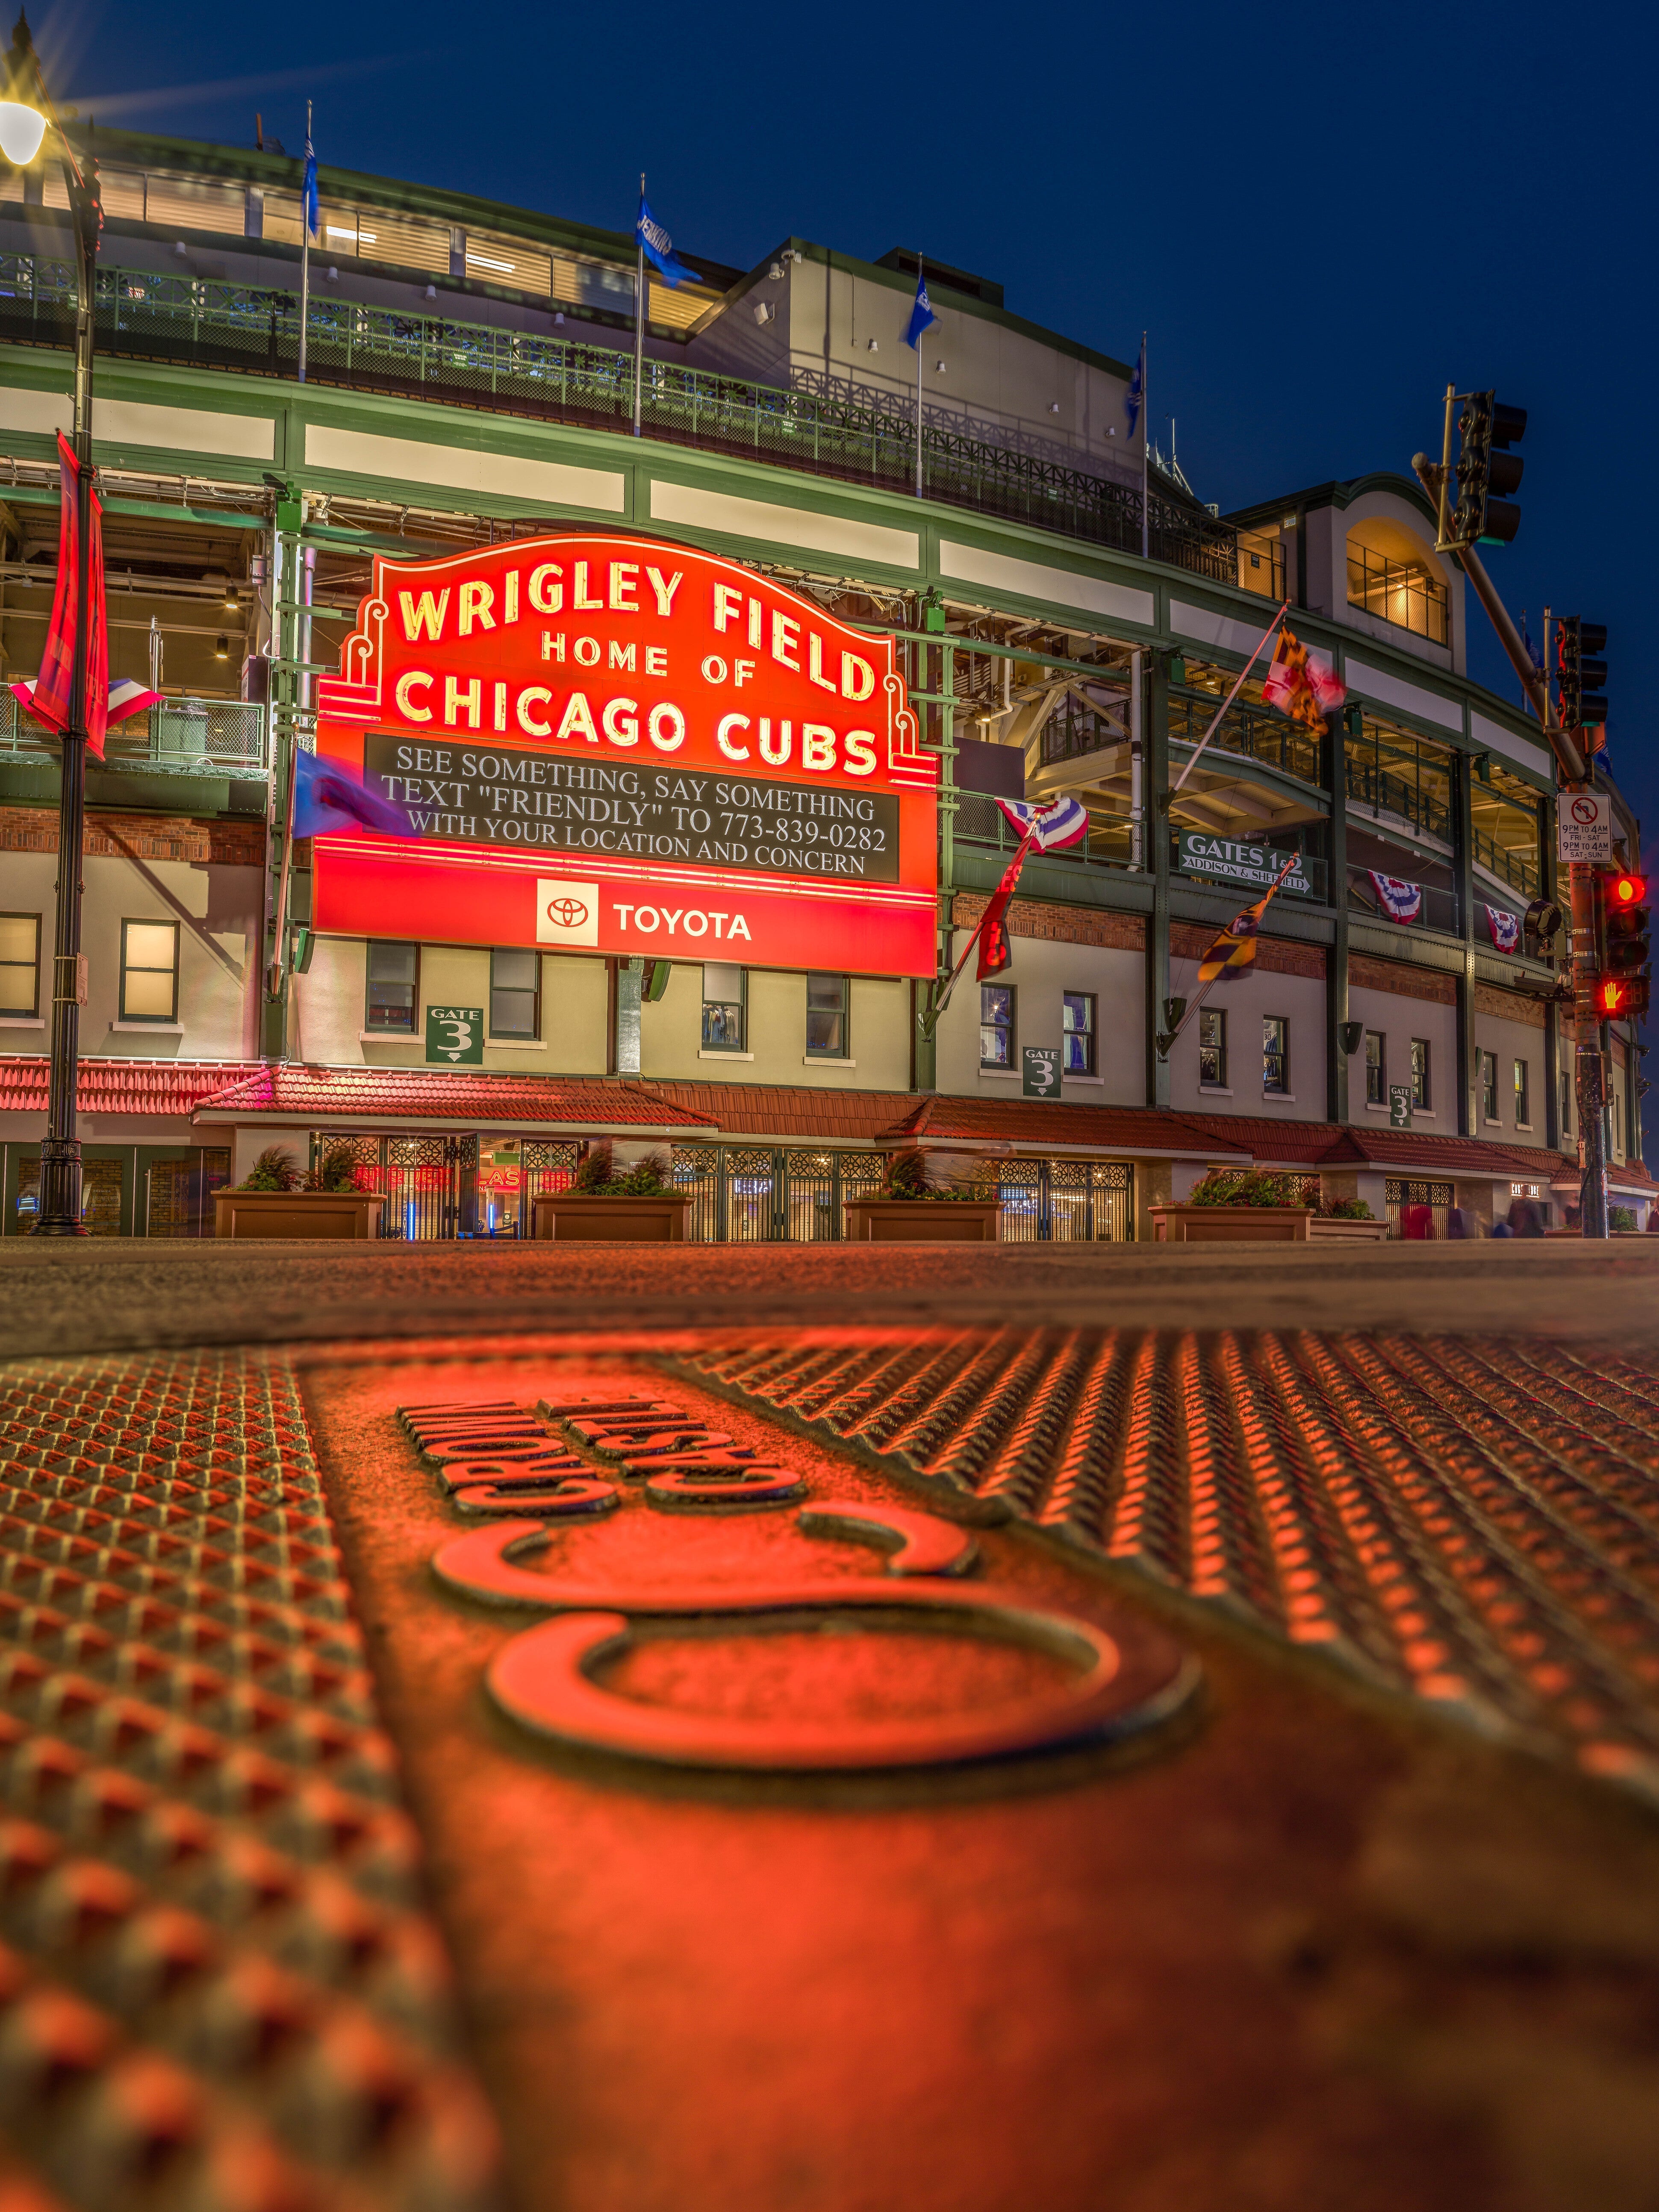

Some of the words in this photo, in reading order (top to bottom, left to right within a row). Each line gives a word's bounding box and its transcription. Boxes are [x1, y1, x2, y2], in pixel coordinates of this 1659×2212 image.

[398, 561, 683, 641] WRIGLEY
[714, 582, 874, 702] FIELD
[542, 630, 668, 677] HOME
[701, 655, 756, 686] OF
[396, 671, 685, 751] CHICAGO
[717, 713, 877, 775] CUBS
[397, 746, 452, 775] SEE
[462, 754, 646, 800] SOMETHING,
[655, 775, 708, 801] SAY
[716, 783, 874, 821] SOMETHING
[381, 775, 470, 808] TEXT
[479, 786, 662, 827] "FRIENDLY"
[672, 807, 710, 833] TO
[719, 812, 886, 852] 773-839-0282
[406, 810, 477, 837] WITH
[483, 817, 557, 844] YOUR
[565, 825, 691, 857] LOCATION
[699, 839, 748, 862] AND
[754, 845, 865, 875] CONCERN
[1187, 835, 1263, 866] GATES
[1187, 857, 1237, 876] ADDISON
[1241, 868, 1248, 878] &
[1252, 870, 1304, 889] SHEFIELD
[613, 904, 751, 940] TOYOTA
[431, 1009, 480, 1020] GATE
[437, 1020, 472, 1051] 3
[1025, 1050, 1058, 1060] GATE
[1031, 1060, 1054, 1086] 3
[1391, 1087, 1409, 1096] GATE
[1394, 1096, 1407, 1118] 3
[396, 1398, 619, 1515] CROWN
[536, 1393, 807, 1512] CASTLE
